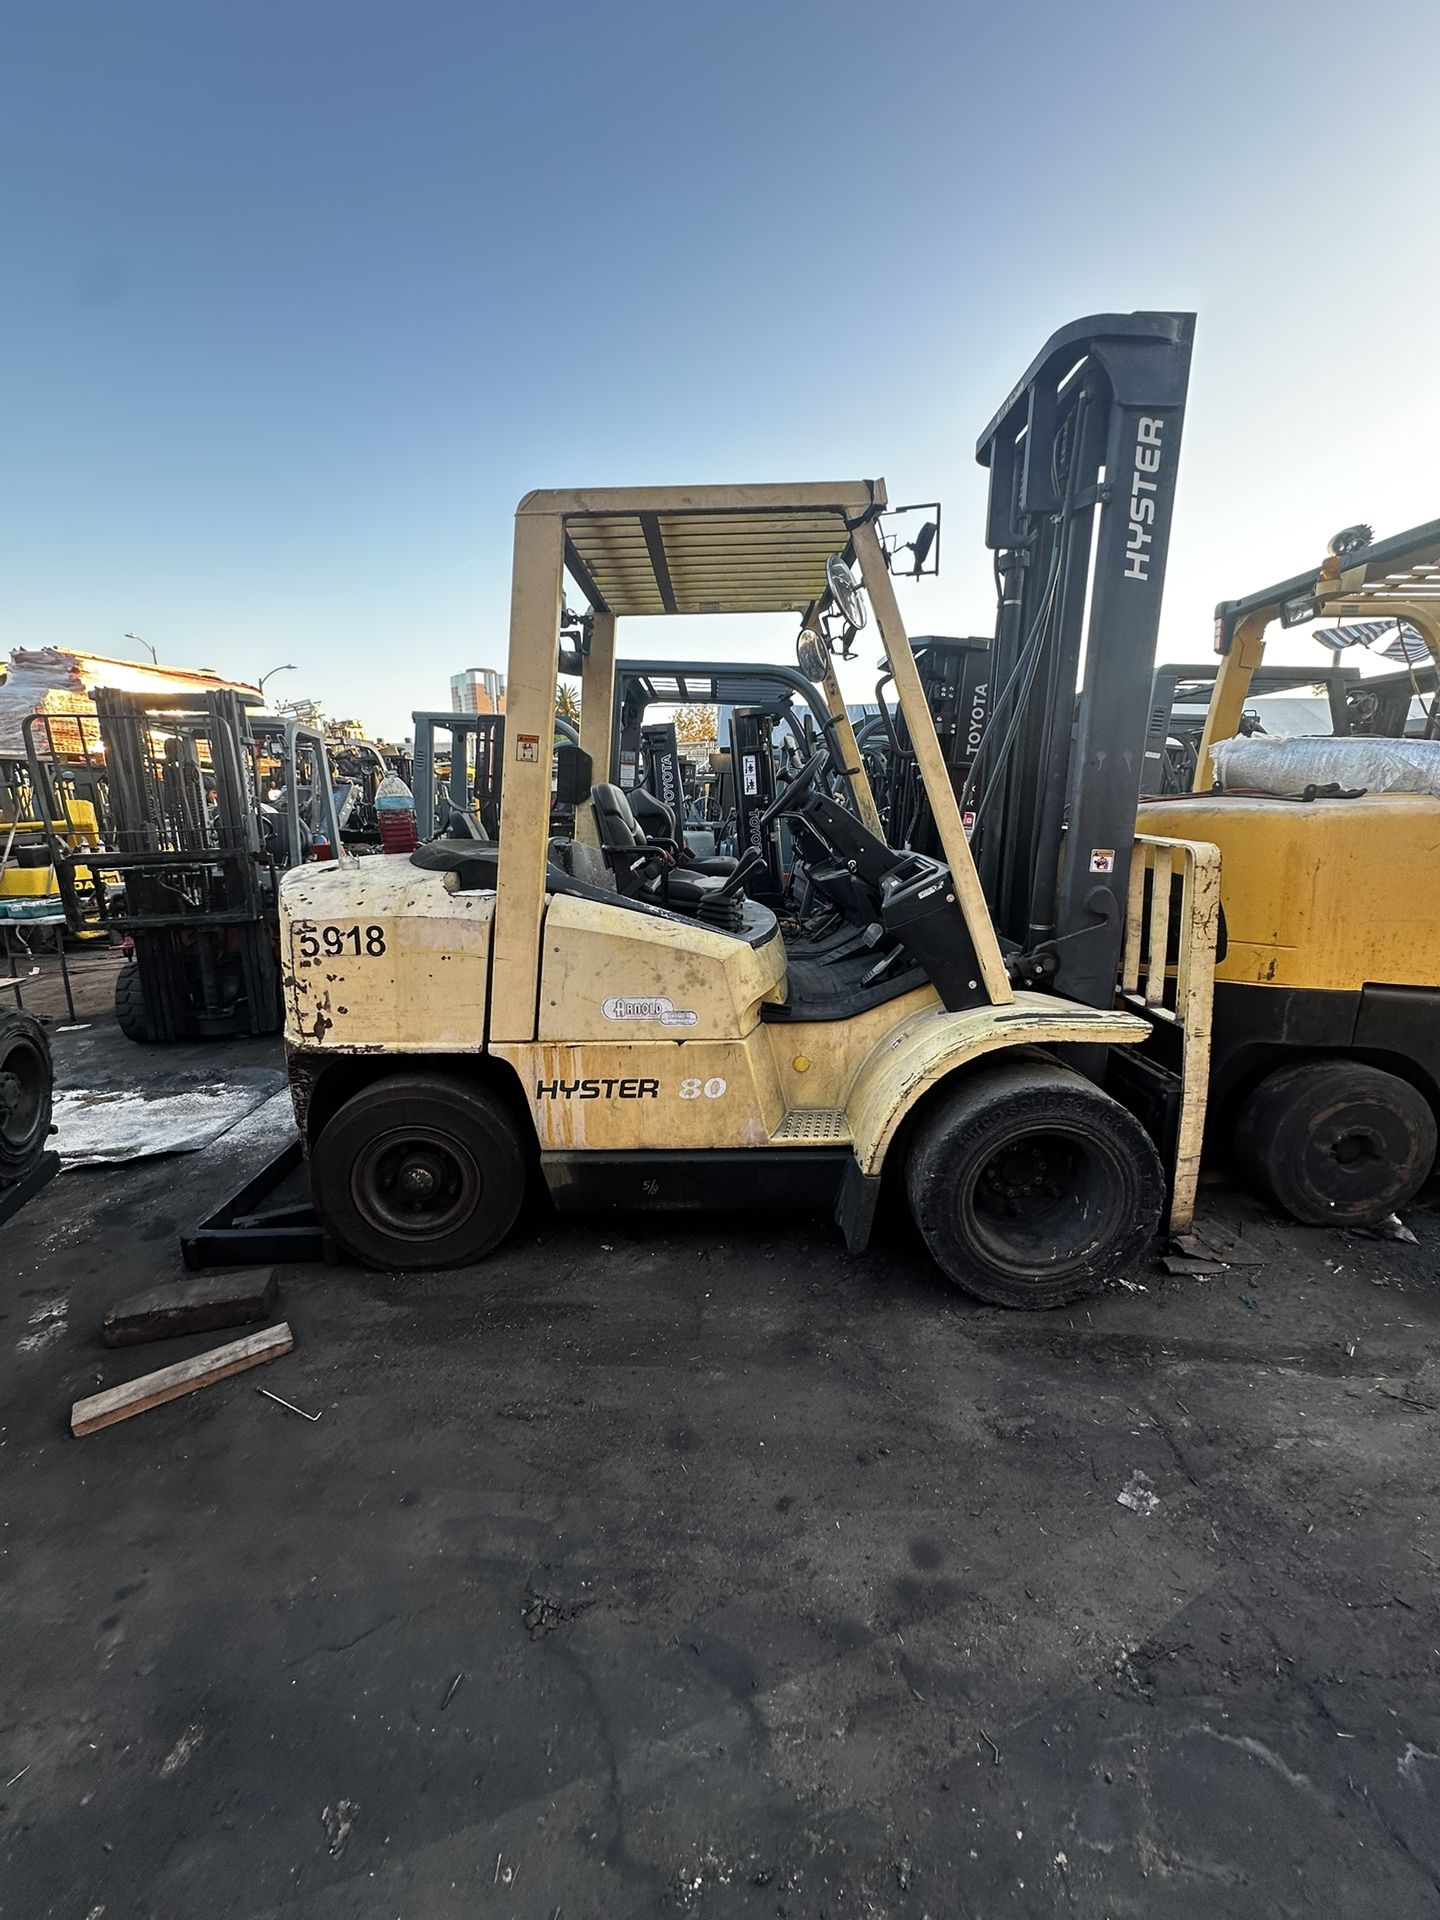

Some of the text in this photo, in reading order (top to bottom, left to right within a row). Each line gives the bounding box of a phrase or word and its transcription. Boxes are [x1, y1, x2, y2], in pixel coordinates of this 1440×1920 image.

[1124, 416, 1164, 581] HYSTER
[966, 683, 988, 755] TOYOTA
[300, 925, 387, 958] 5918
[536, 1077, 727, 1100] HYSTER 80
